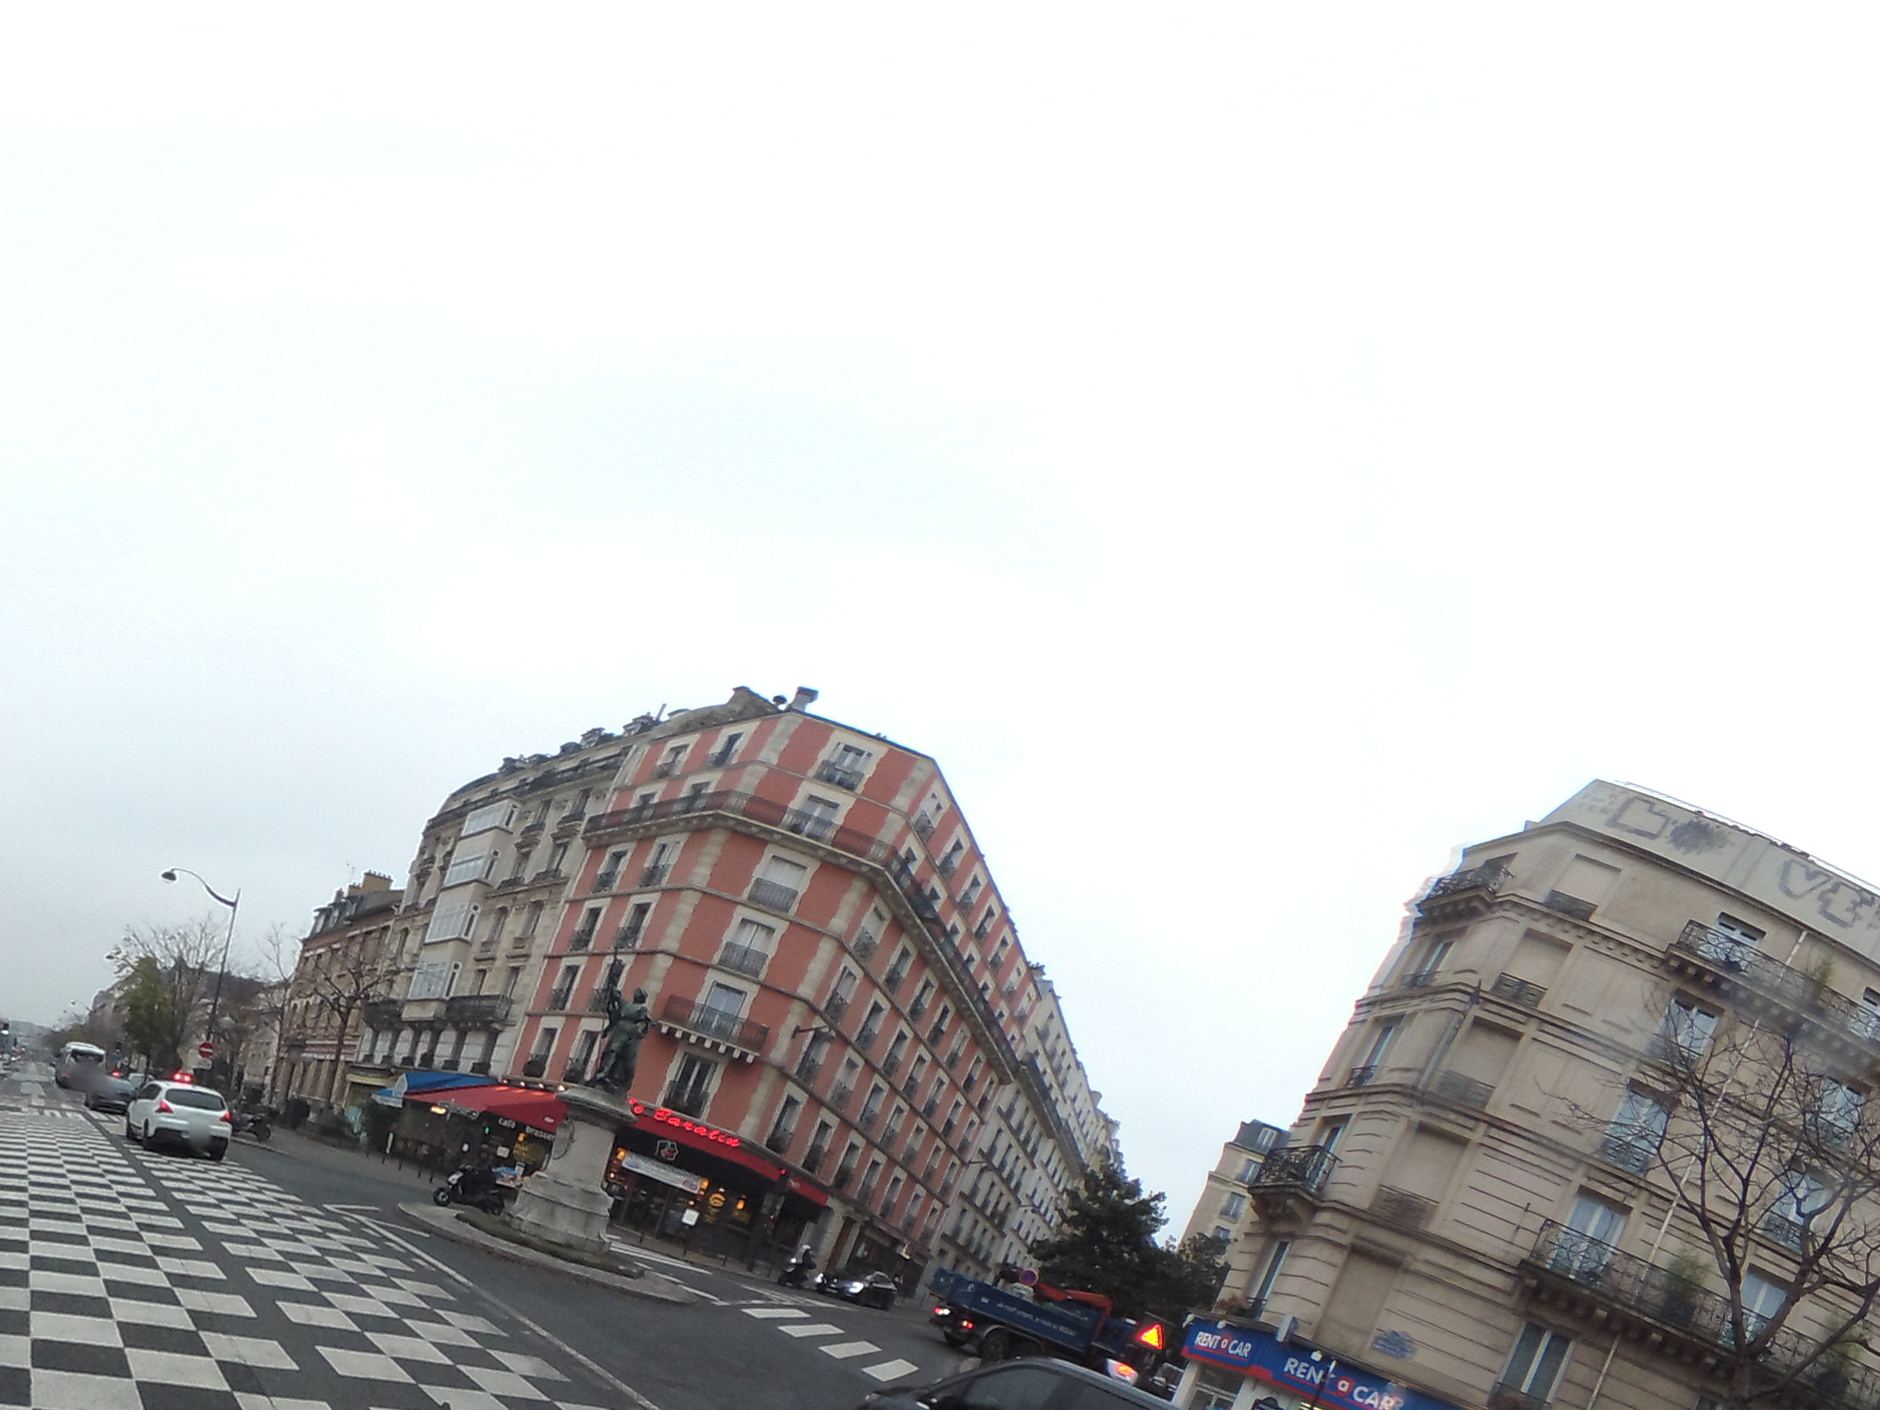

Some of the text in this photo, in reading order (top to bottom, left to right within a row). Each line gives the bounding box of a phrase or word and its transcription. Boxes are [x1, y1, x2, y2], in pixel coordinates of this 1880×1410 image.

[653, 1107, 740, 1149] Baratin
[1194, 1331, 1223, 1350] RENT
[1227, 1339, 1252, 1358] CAR
